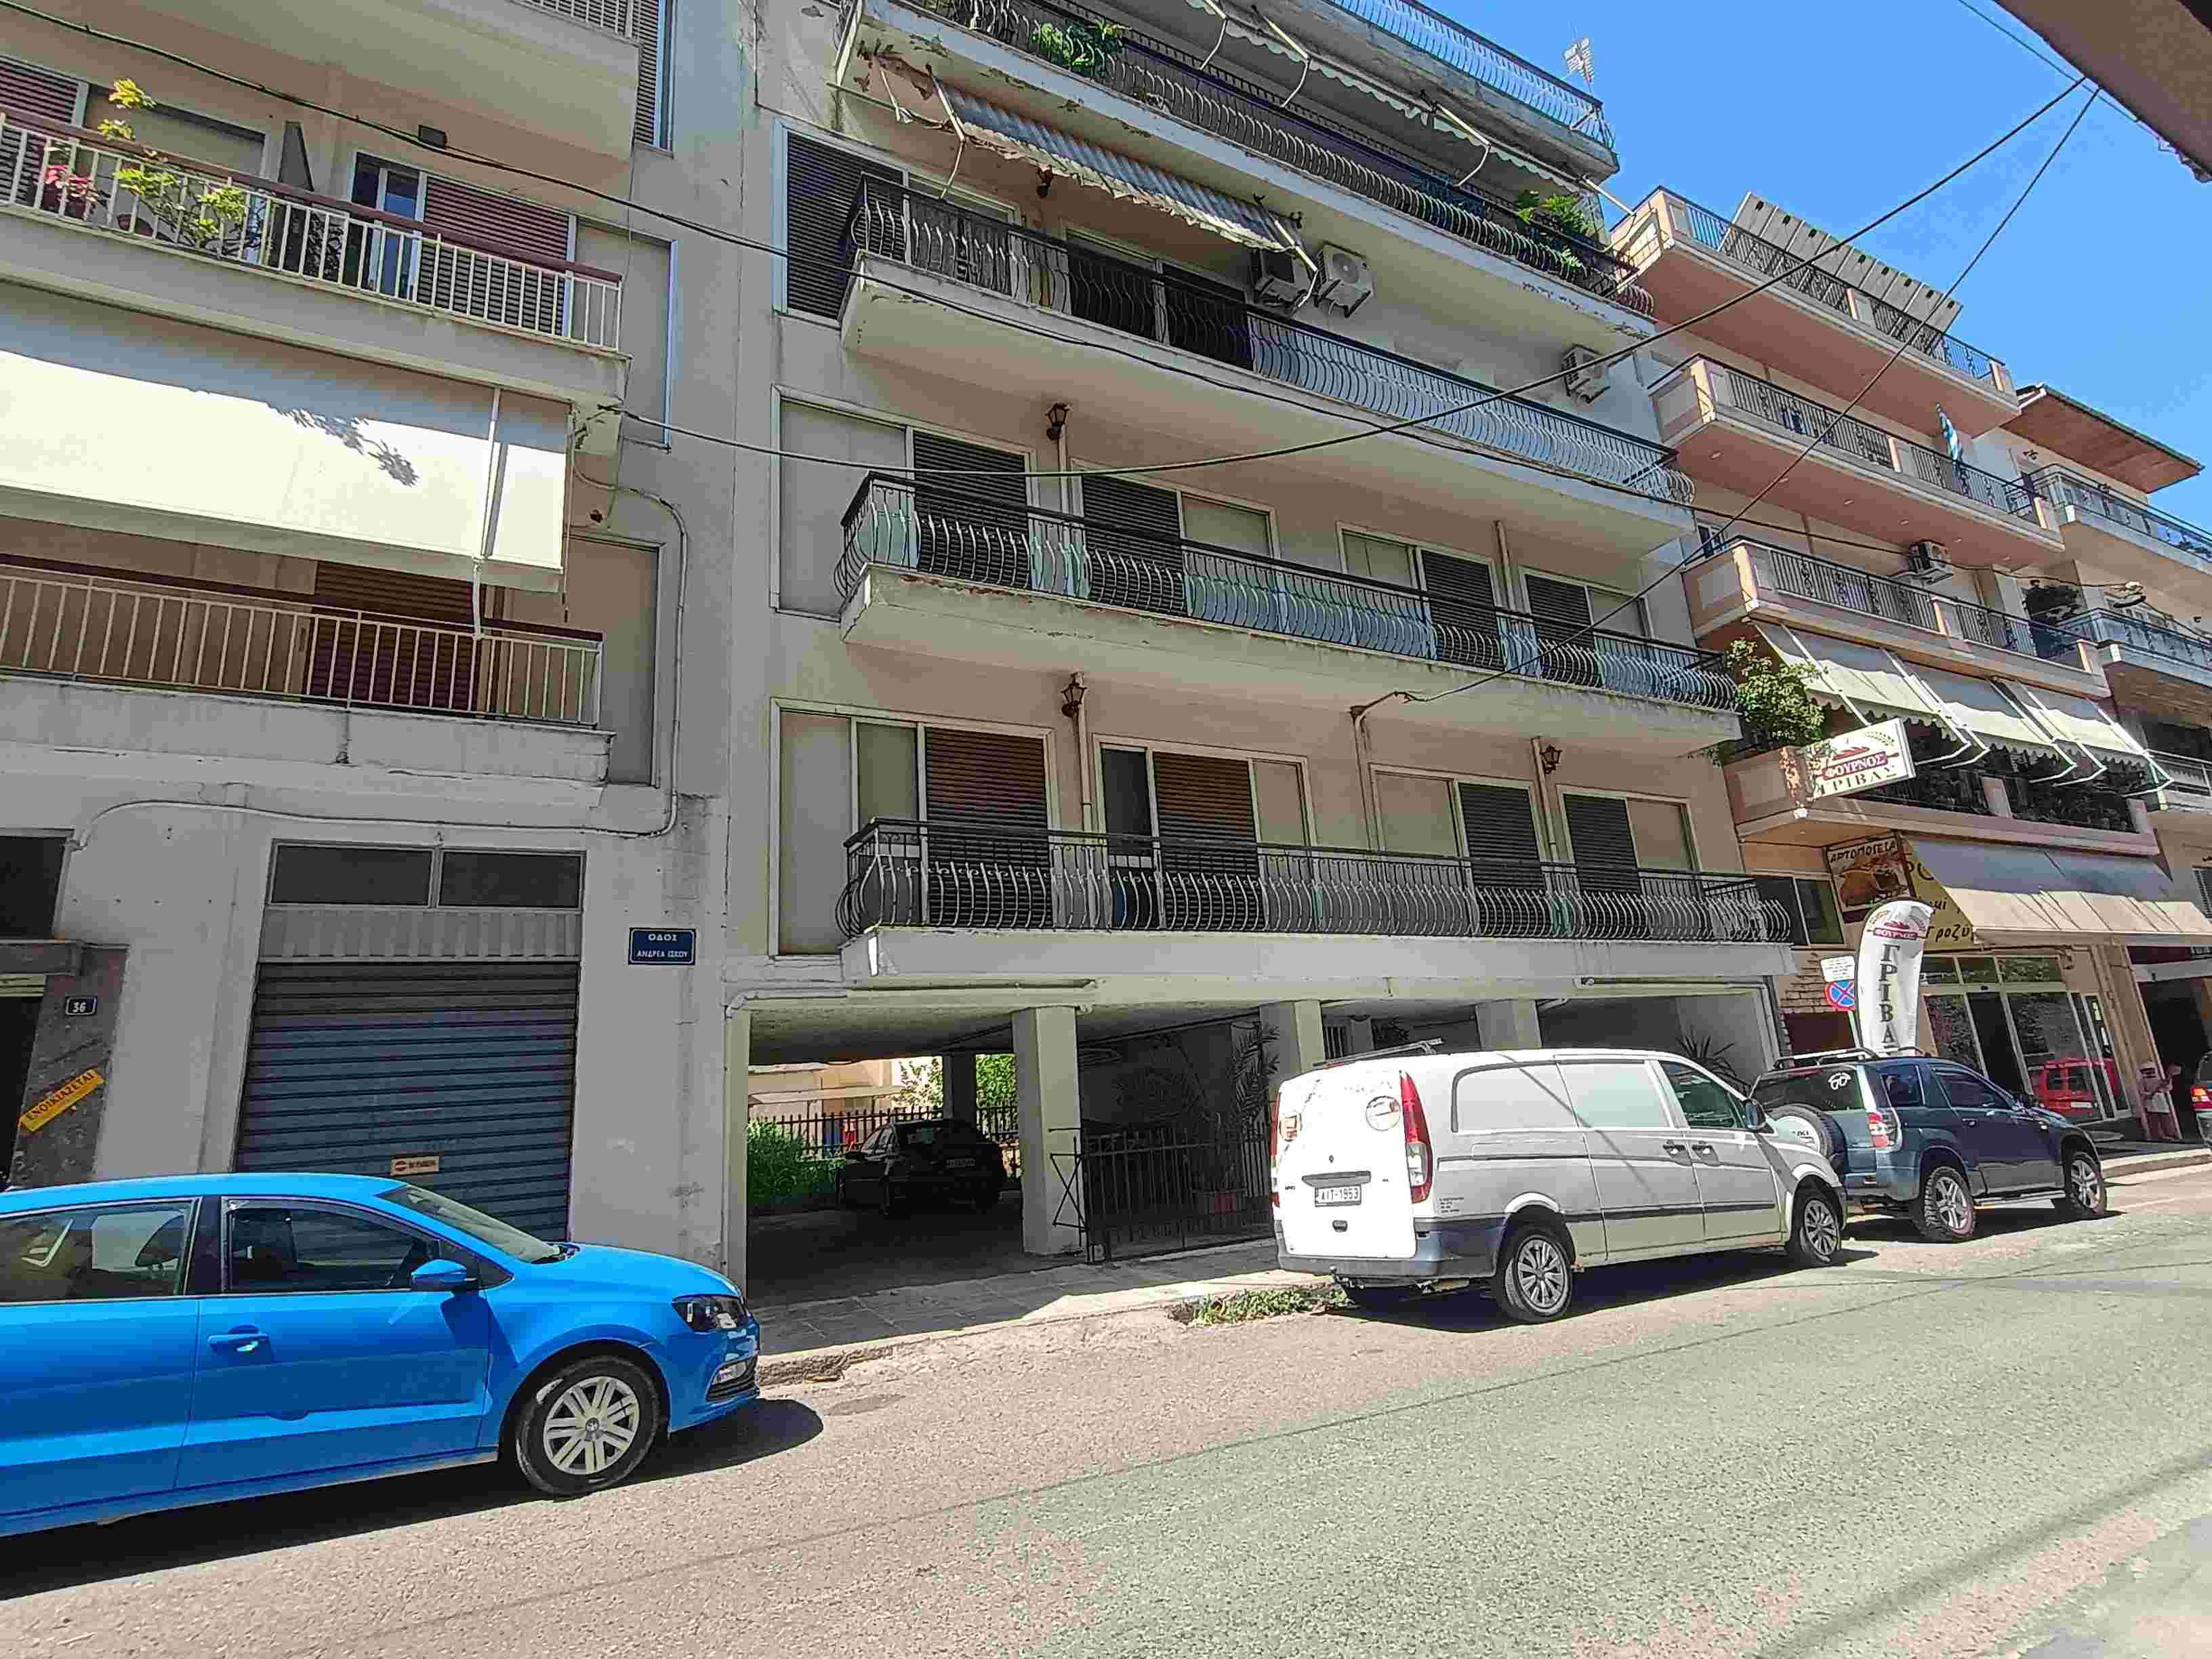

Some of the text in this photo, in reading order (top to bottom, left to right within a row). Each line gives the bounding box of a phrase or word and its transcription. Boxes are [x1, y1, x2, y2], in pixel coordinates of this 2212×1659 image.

[1825, 752, 1887, 779] ΦΟΥΡΝΟΣ
[648, 933, 678, 941] ΟΔΟΣ
[73, 1001, 86, 1012] 36
